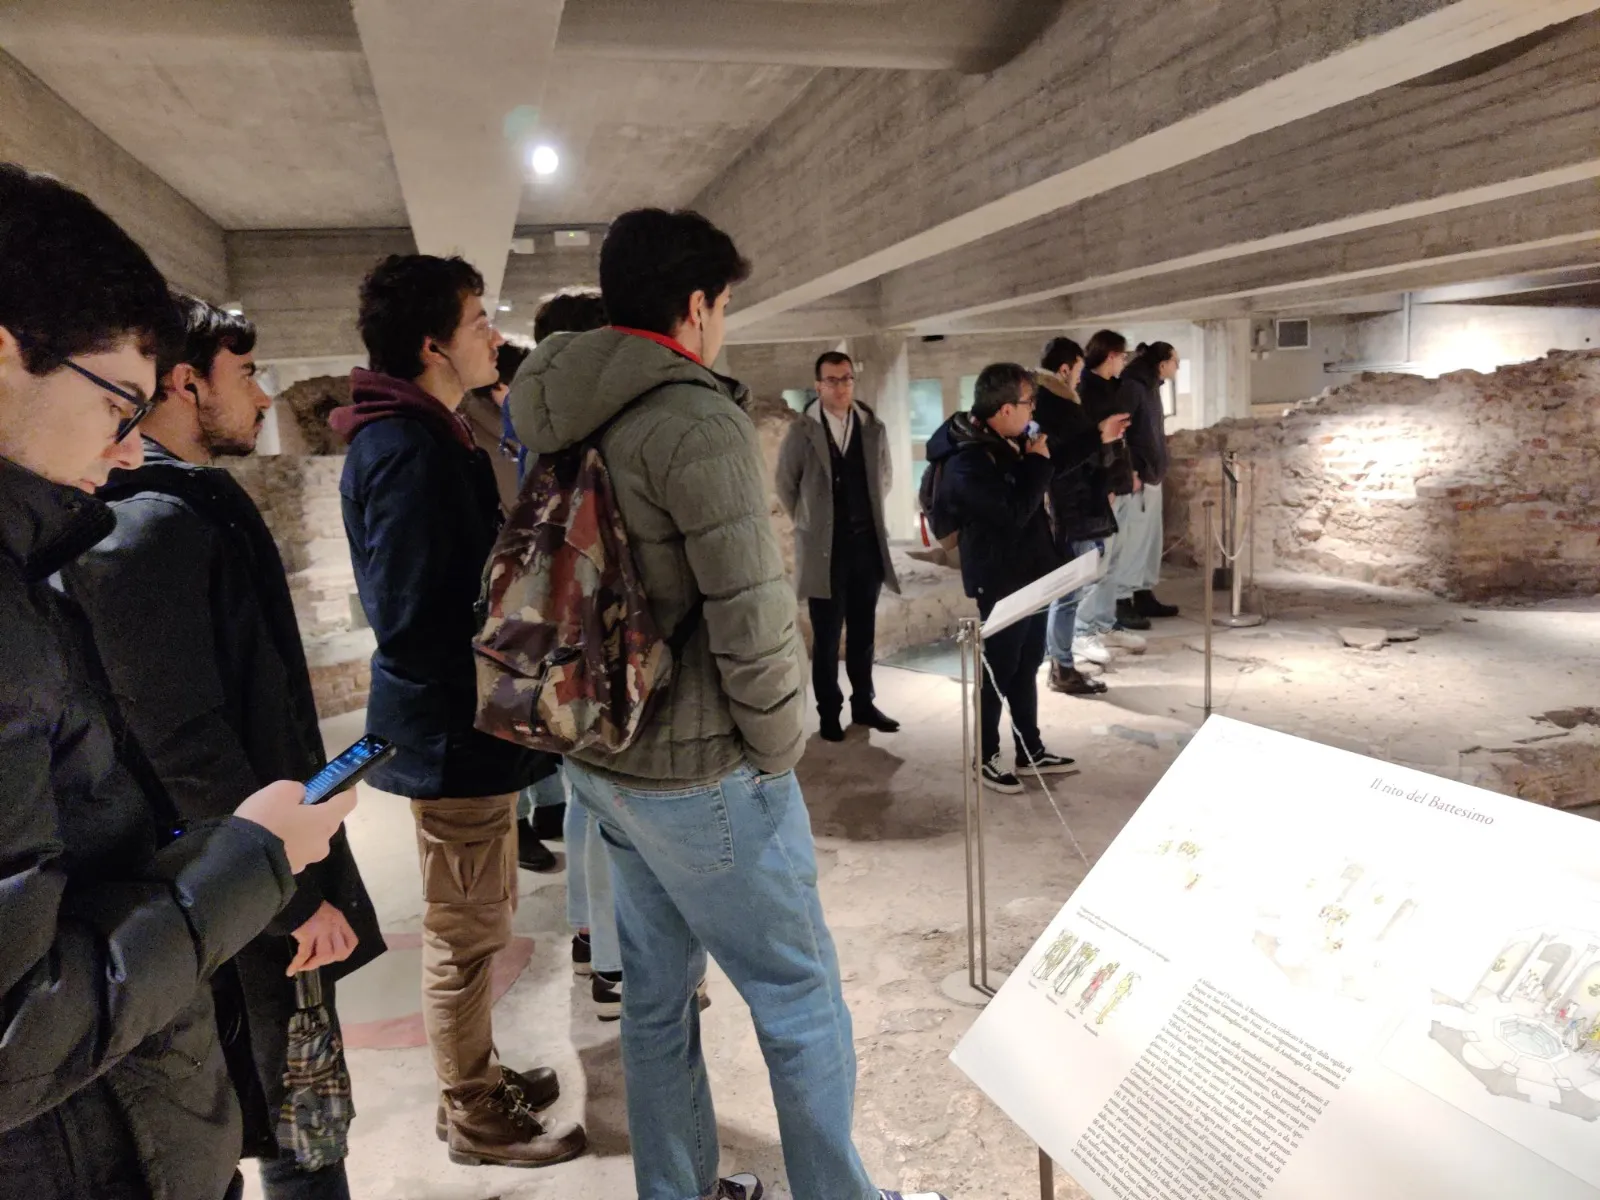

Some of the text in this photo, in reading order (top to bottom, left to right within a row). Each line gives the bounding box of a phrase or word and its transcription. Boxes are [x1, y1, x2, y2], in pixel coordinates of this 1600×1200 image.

[1370, 778, 1494, 825] Il rito del Battesimo
